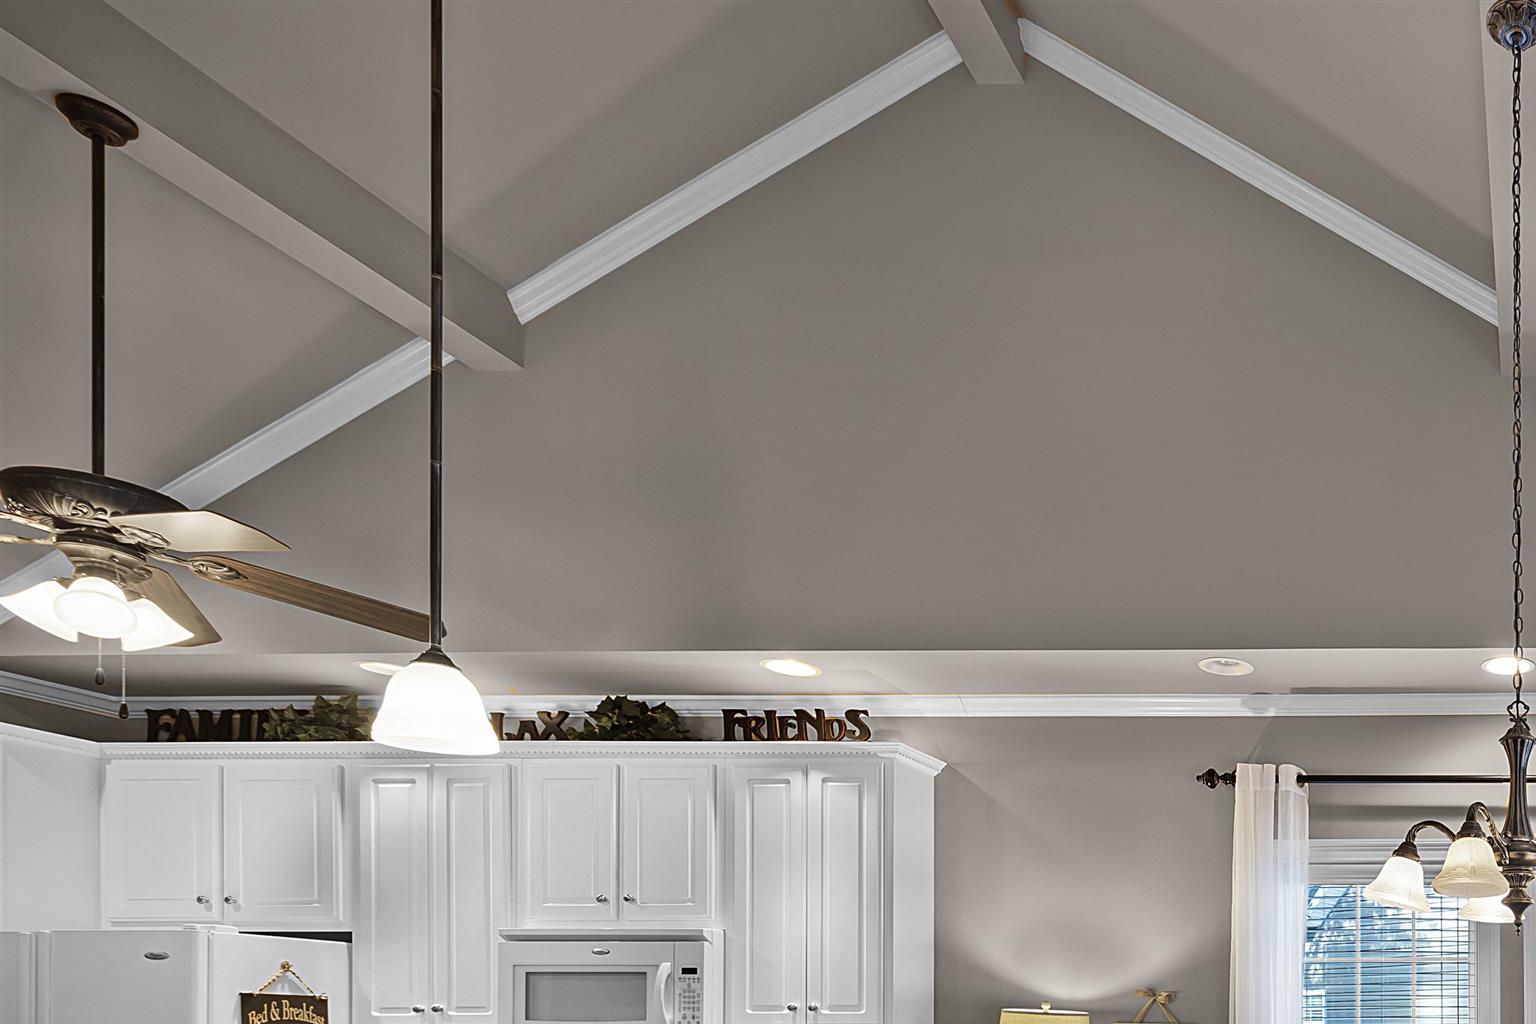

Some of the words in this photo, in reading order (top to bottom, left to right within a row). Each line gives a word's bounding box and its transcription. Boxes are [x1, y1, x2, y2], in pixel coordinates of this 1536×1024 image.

[145, 708, 310, 741] FAMI
[721, 708, 872, 741] FRIENDS
[270, 1001, 280, 1021] &
